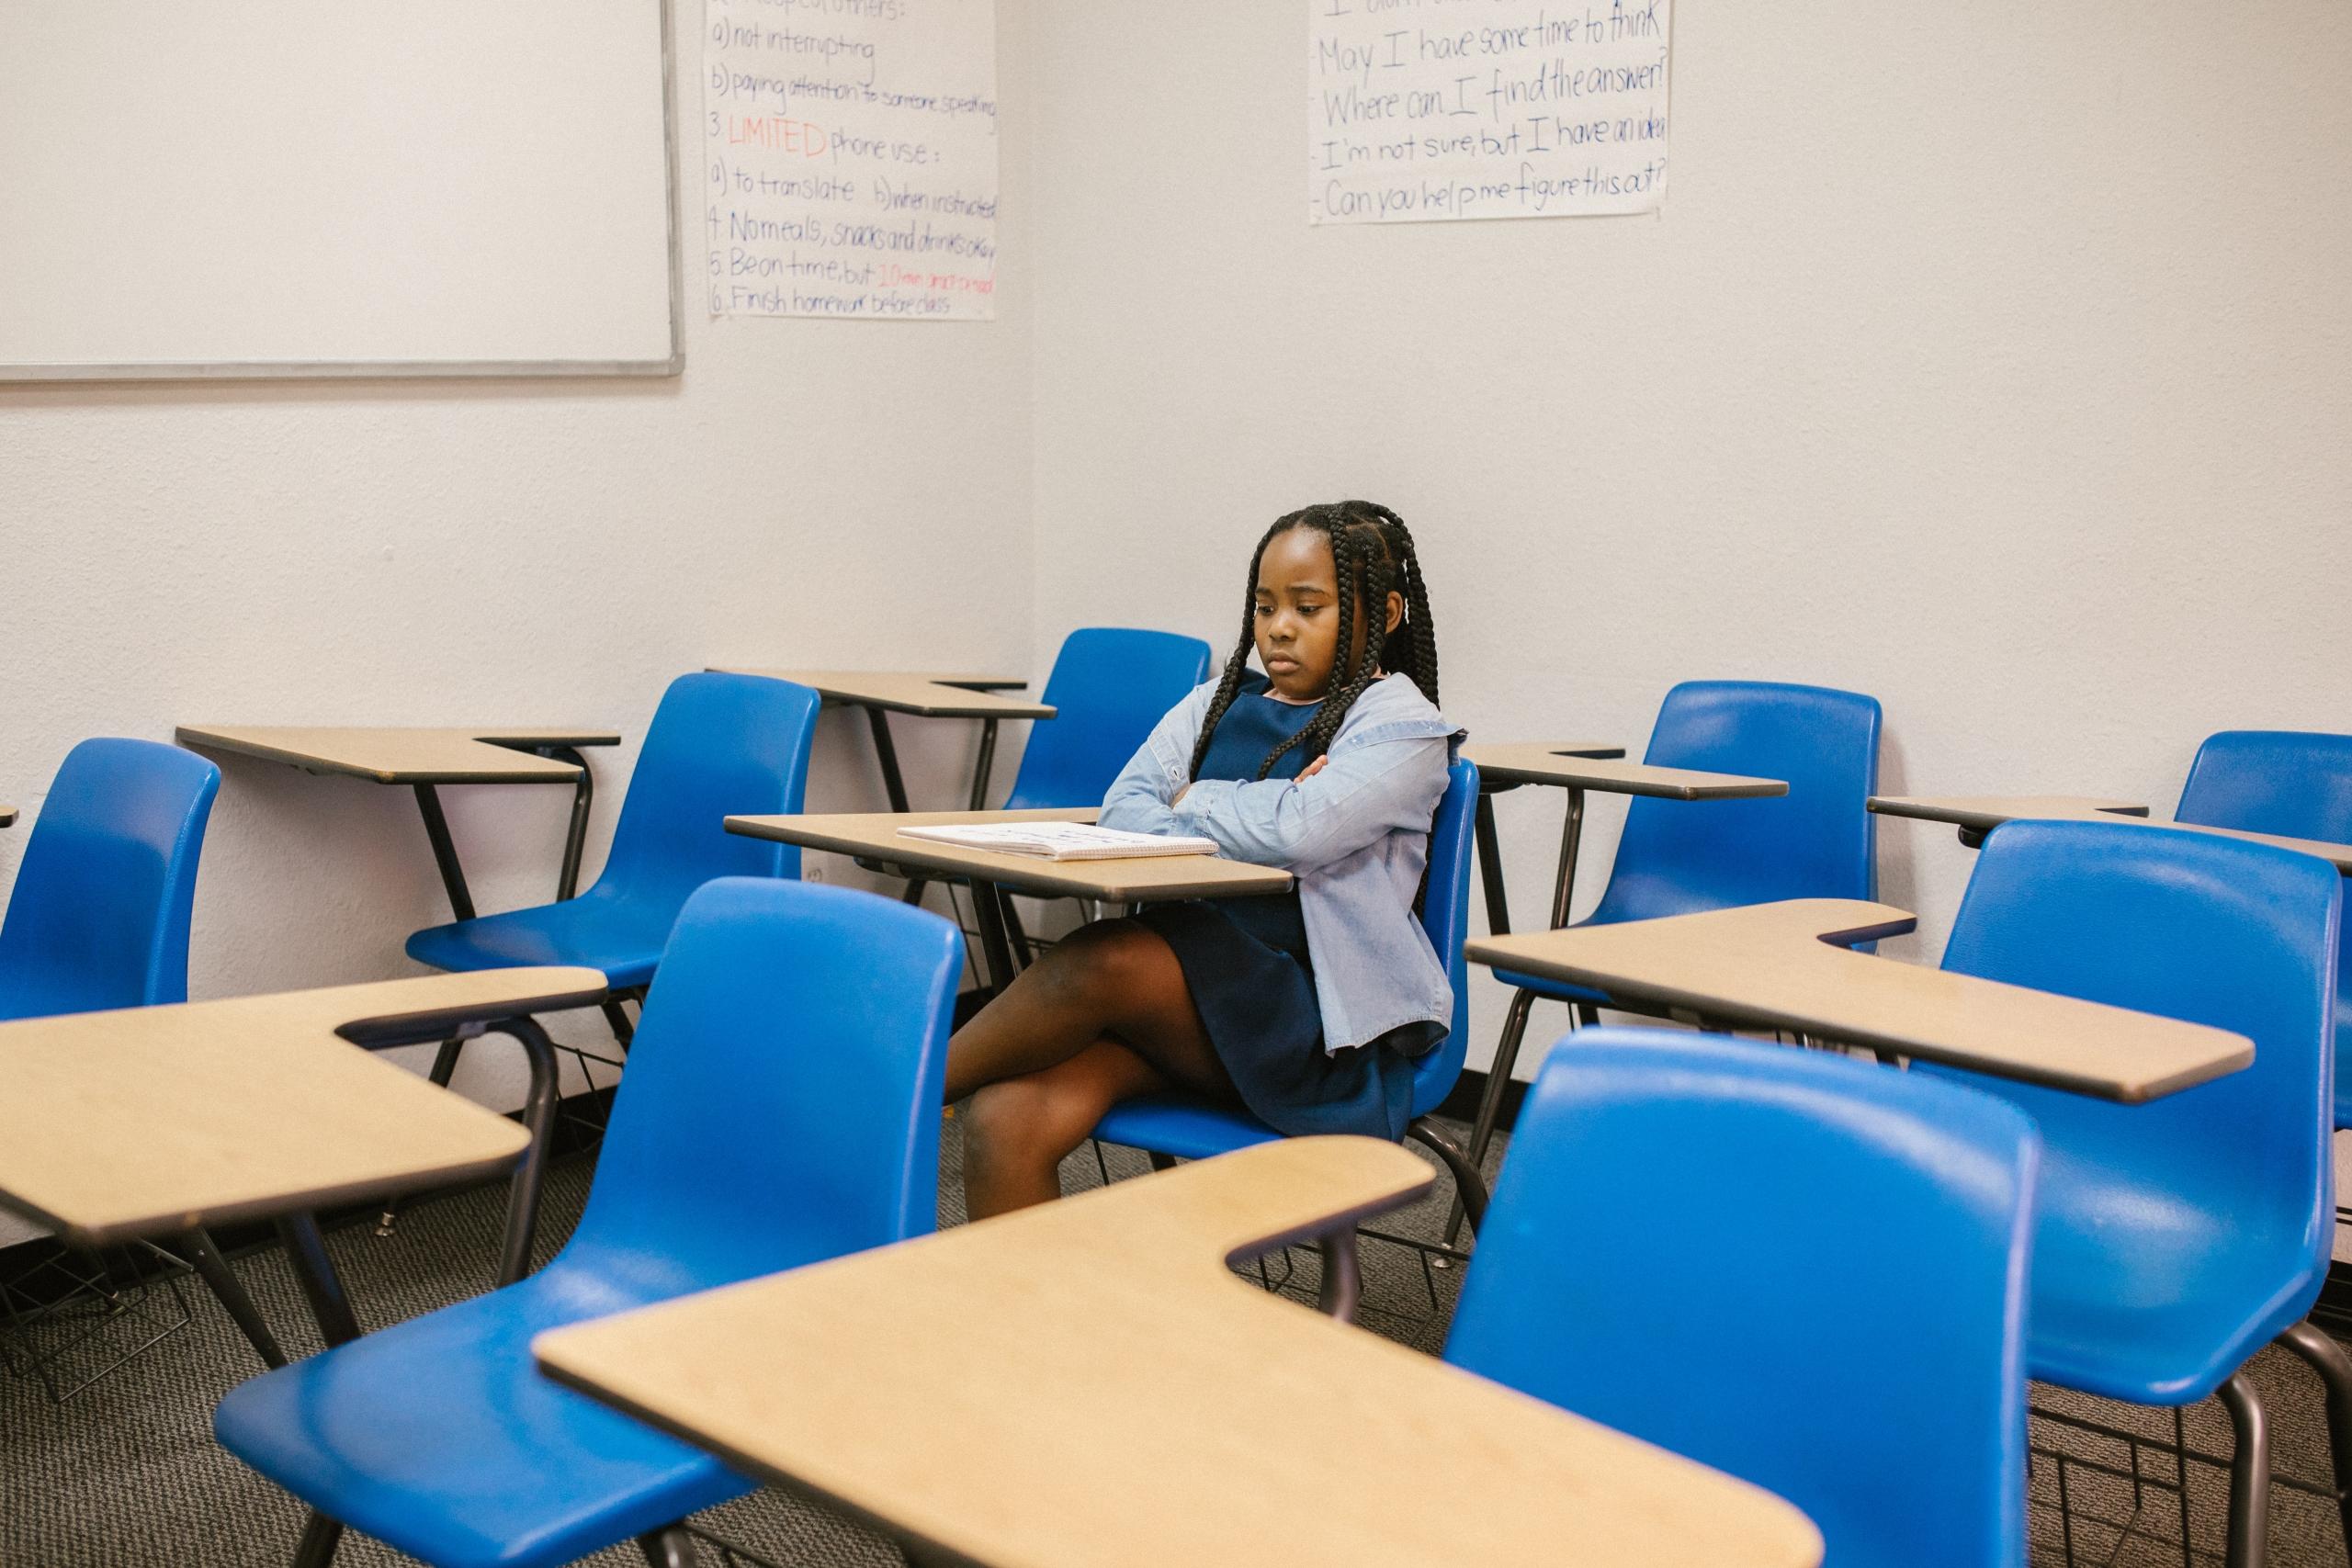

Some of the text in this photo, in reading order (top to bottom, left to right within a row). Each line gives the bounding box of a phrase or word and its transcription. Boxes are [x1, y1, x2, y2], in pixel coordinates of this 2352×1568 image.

[766, 28, 876, 87] interrupting
[1320, 37, 1374, 89] May
[1382, 30, 1409, 67] I
[1420, 28, 1475, 61] have
[1479, 27, 1529, 54] some
[1532, 9, 1579, 47] time
[1586, 7, 1604, 43] to
[733, 73, 787, 116] paying
[1323, 85, 1400, 127] Where
[1407, 90, 1443, 119] can
[1449, 76, 1477, 116] I
[1485, 63, 1547, 123] find
[1549, 58, 1584, 100] the
[729, 114, 828, 158] LIMITED
[831, 126, 886, 165] phone
[1320, 137, 1370, 171] I'm
[1380, 134, 1416, 163] not
[1479, 127, 1521, 155] but
[1526, 117, 1551, 153] I
[1556, 117, 1609, 146] have
[1613, 117, 1634, 142] an
[733, 167, 754, 193] to
[757, 171, 854, 201] translate
[1378, 187, 1417, 220] you
[1422, 180, 1476, 218] help
[1479, 182, 1510, 200] me
[1514, 161, 1579, 211] figure
[1584, 165, 1621, 198] this
[731, 285, 786, 312] Finish
